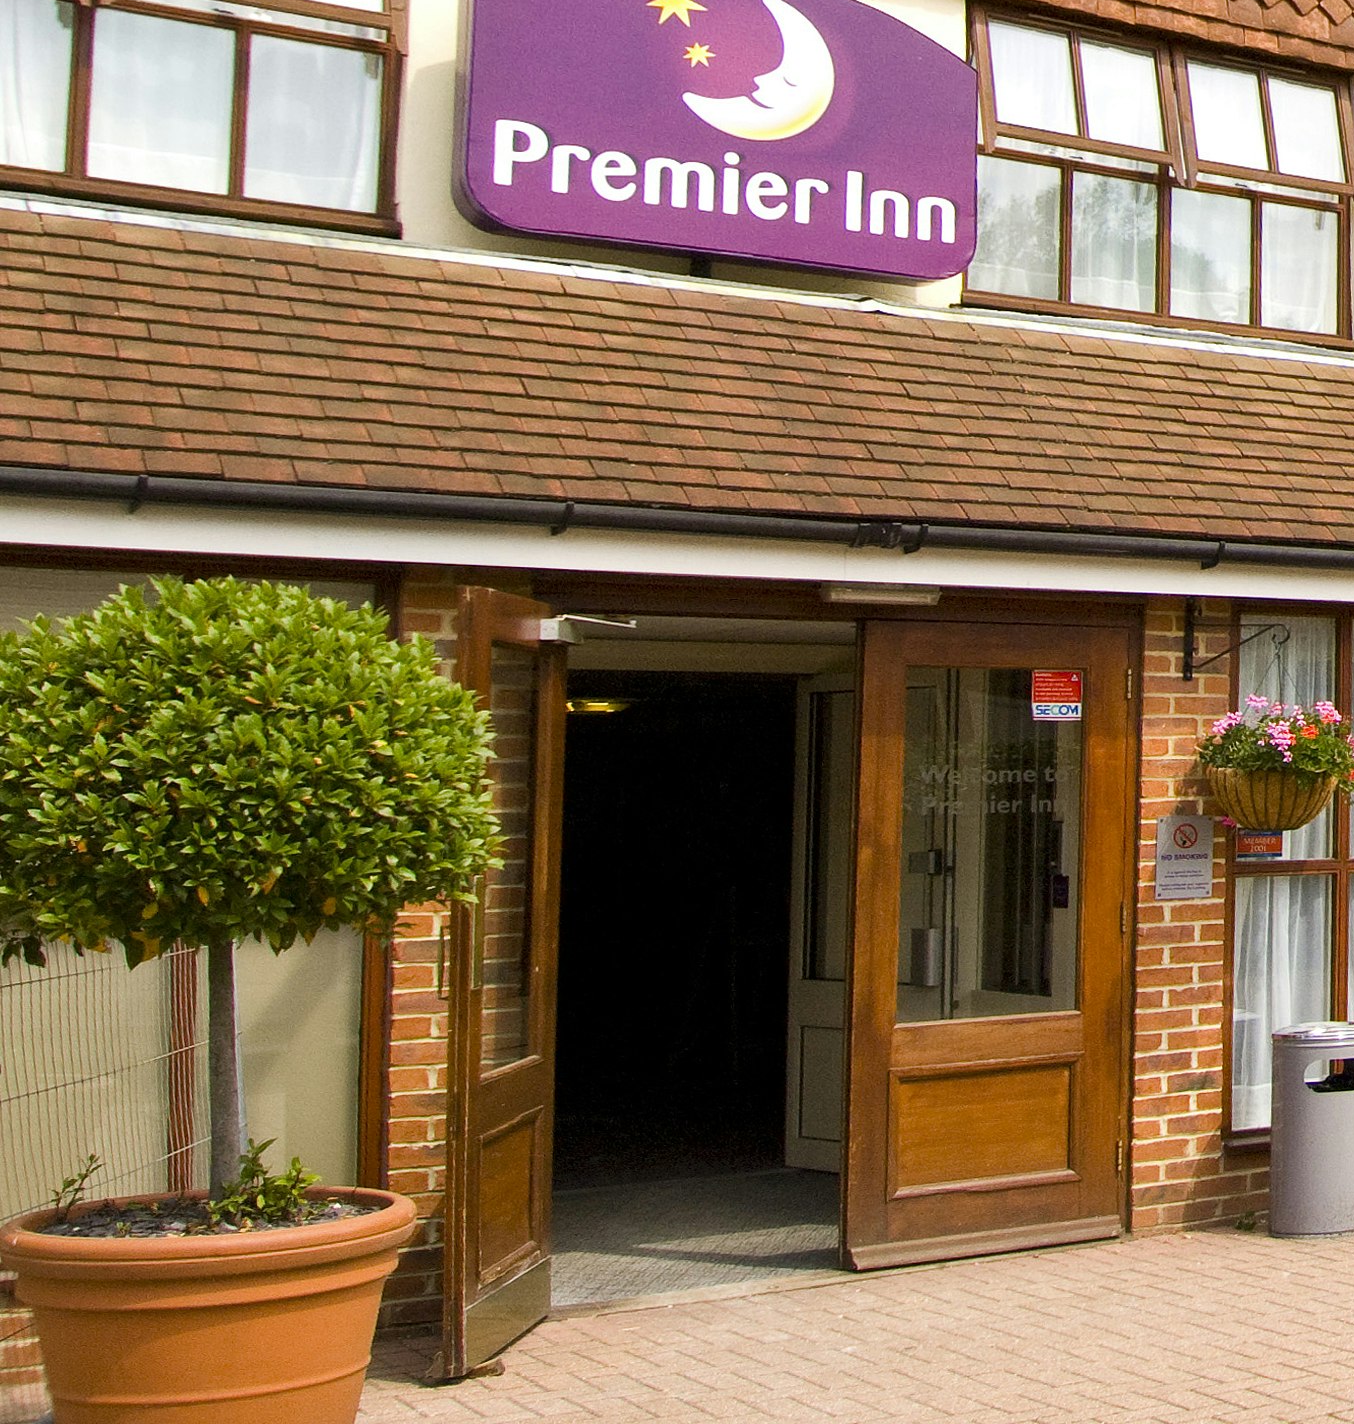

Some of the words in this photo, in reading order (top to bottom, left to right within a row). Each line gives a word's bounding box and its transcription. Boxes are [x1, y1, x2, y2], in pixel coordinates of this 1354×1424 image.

[492, 119, 829, 225] Premier
[845, 170, 957, 245] Inn
[1035, 705, 1078, 715] SECOM
[920, 765, 1037, 784] Weome
[921, 794, 1022, 816] Preier
